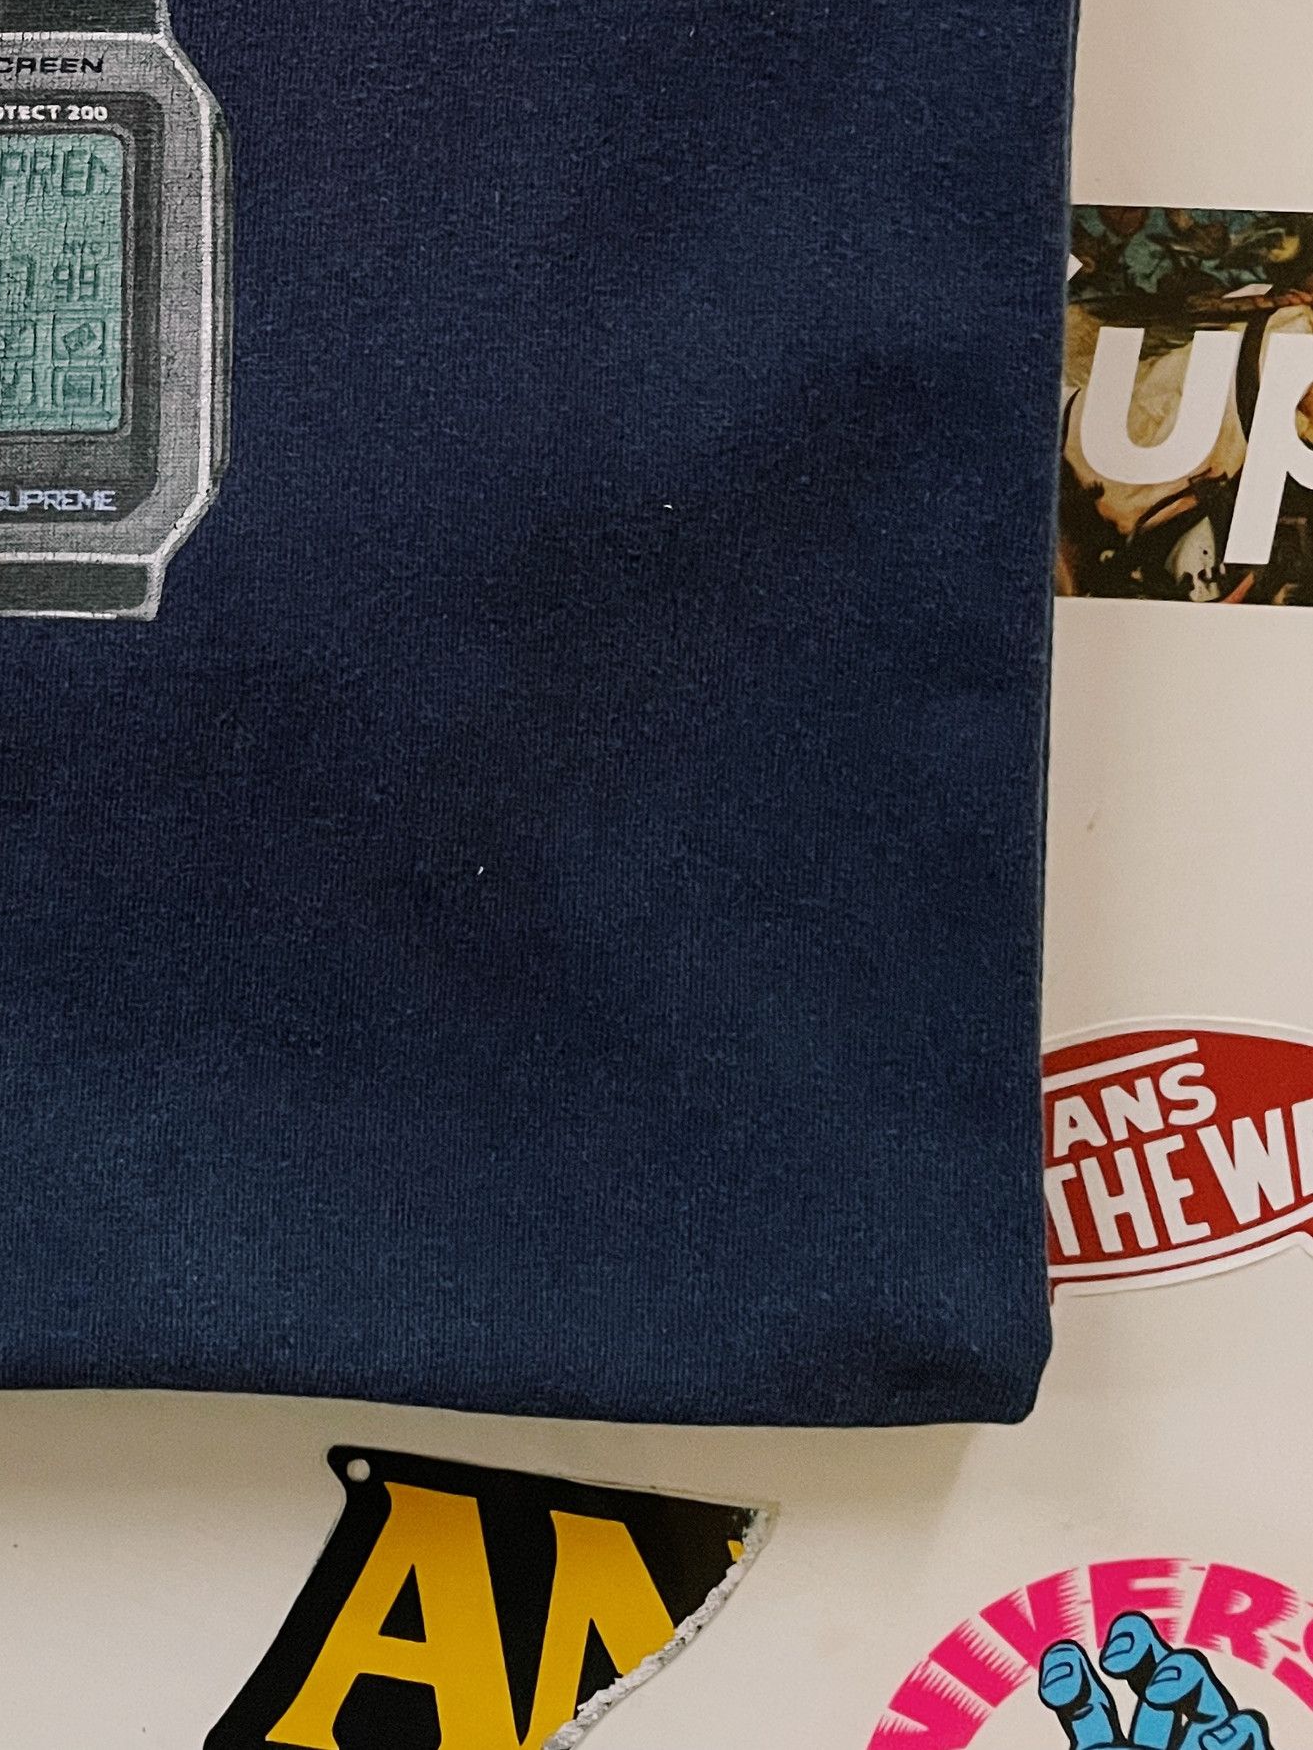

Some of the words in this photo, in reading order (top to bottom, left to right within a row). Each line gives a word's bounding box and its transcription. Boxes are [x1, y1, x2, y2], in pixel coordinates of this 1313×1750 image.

[67, 104, 108, 122] 200
[1067, 253, 1313, 565] up
[1043, 1134, 1211, 1257] THE
